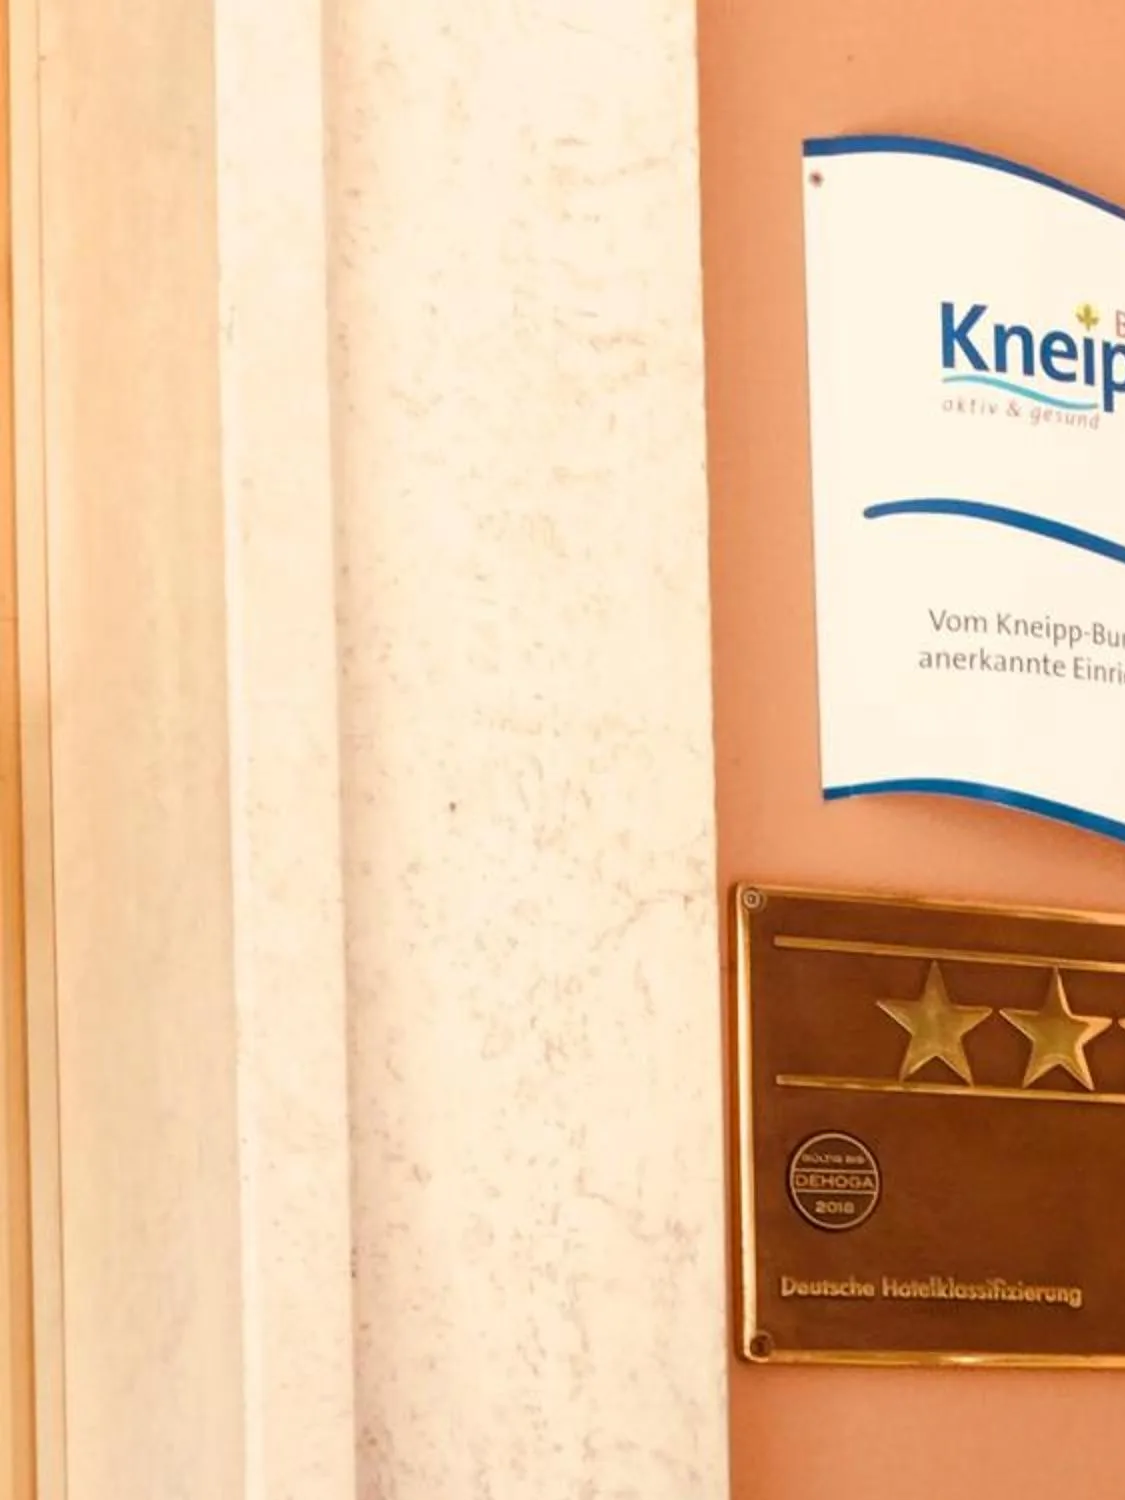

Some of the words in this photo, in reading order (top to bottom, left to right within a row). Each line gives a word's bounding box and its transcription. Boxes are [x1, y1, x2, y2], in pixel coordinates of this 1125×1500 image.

[941, 397, 999, 416] aktiv
[1005, 401, 1022, 418] &
[1029, 405, 1101, 430] gesund
[927, 607, 988, 634] Vom
[918, 647, 1067, 679] anerkannte
[795, 1173, 875, 1190] DEHOGA
[780, 1275, 876, 1298] Deutsche
[881, 1276, 1083, 1308] Hotelklassifizierung
